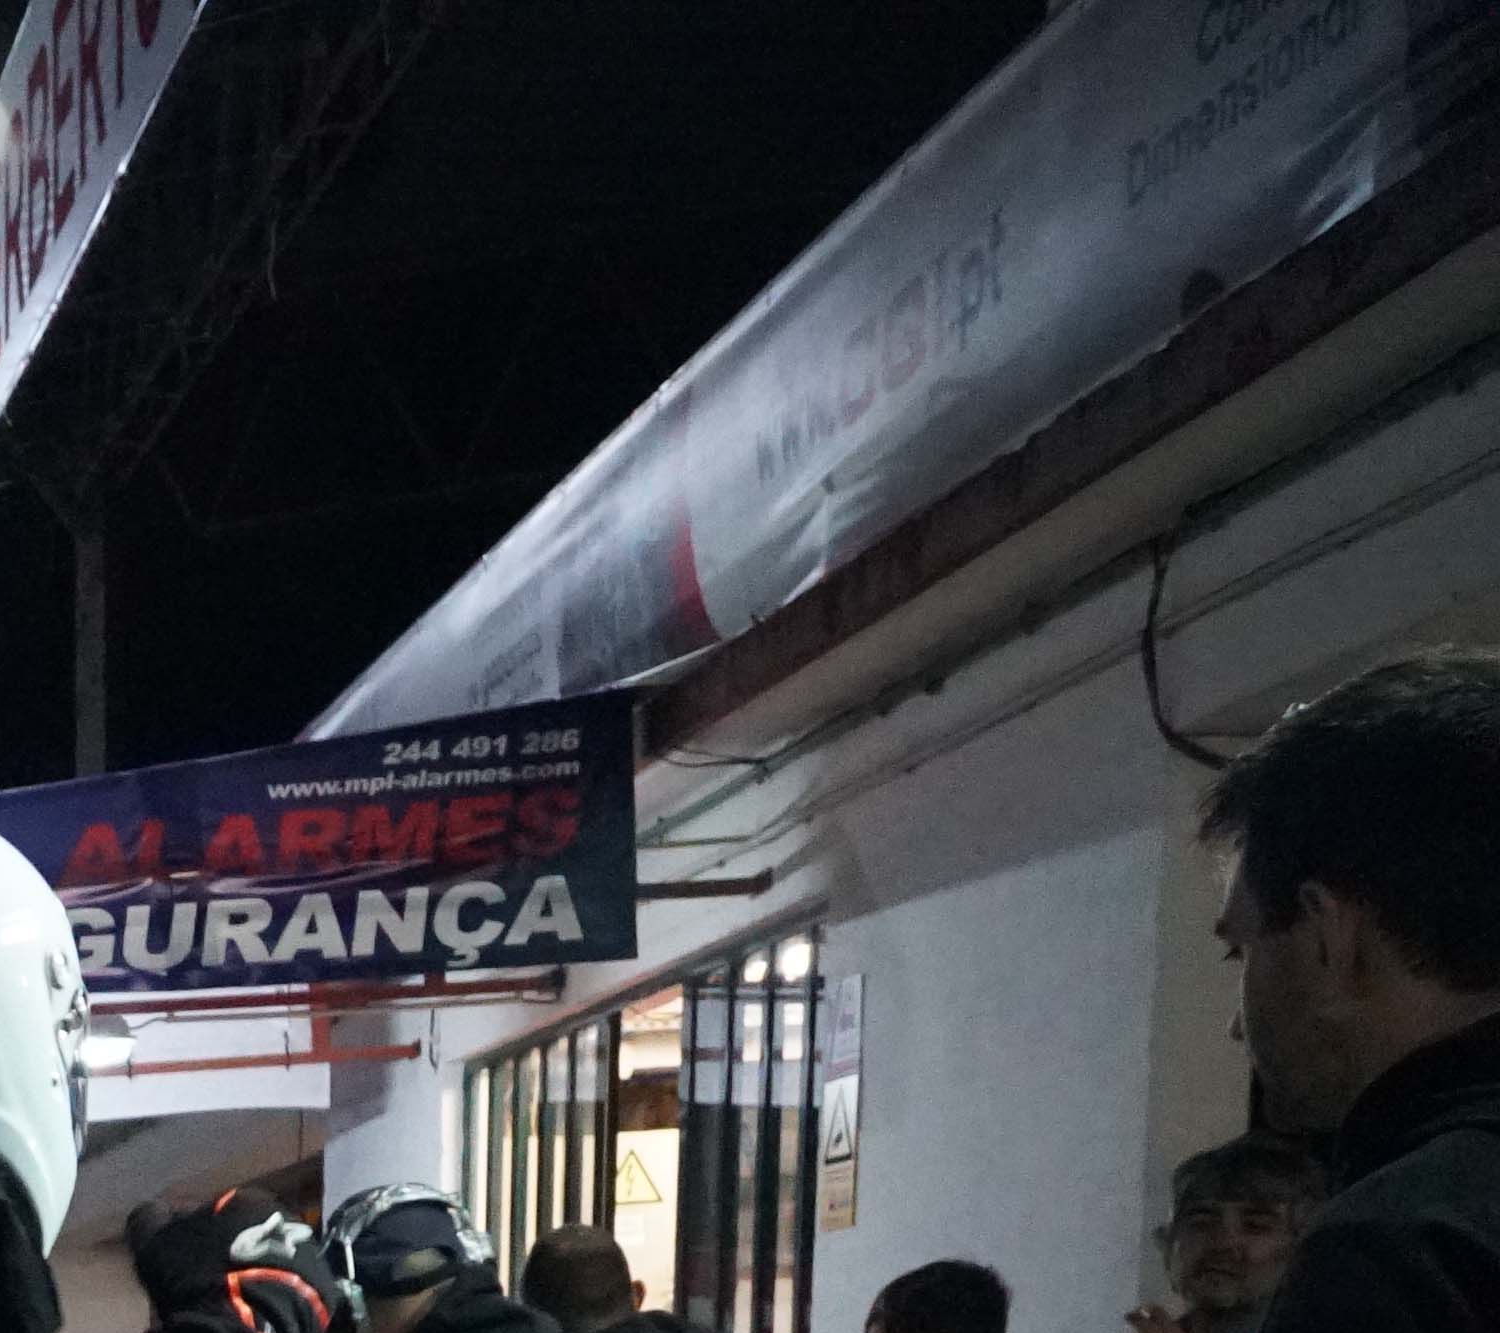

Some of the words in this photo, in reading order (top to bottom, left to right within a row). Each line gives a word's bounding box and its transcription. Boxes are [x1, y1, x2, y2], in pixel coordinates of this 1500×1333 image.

[382, 739, 441, 767] 244
[451, 733, 509, 760] 491
[58, 784, 582, 890] ALARMES
[70, 873, 585, 977] GURANÇA
